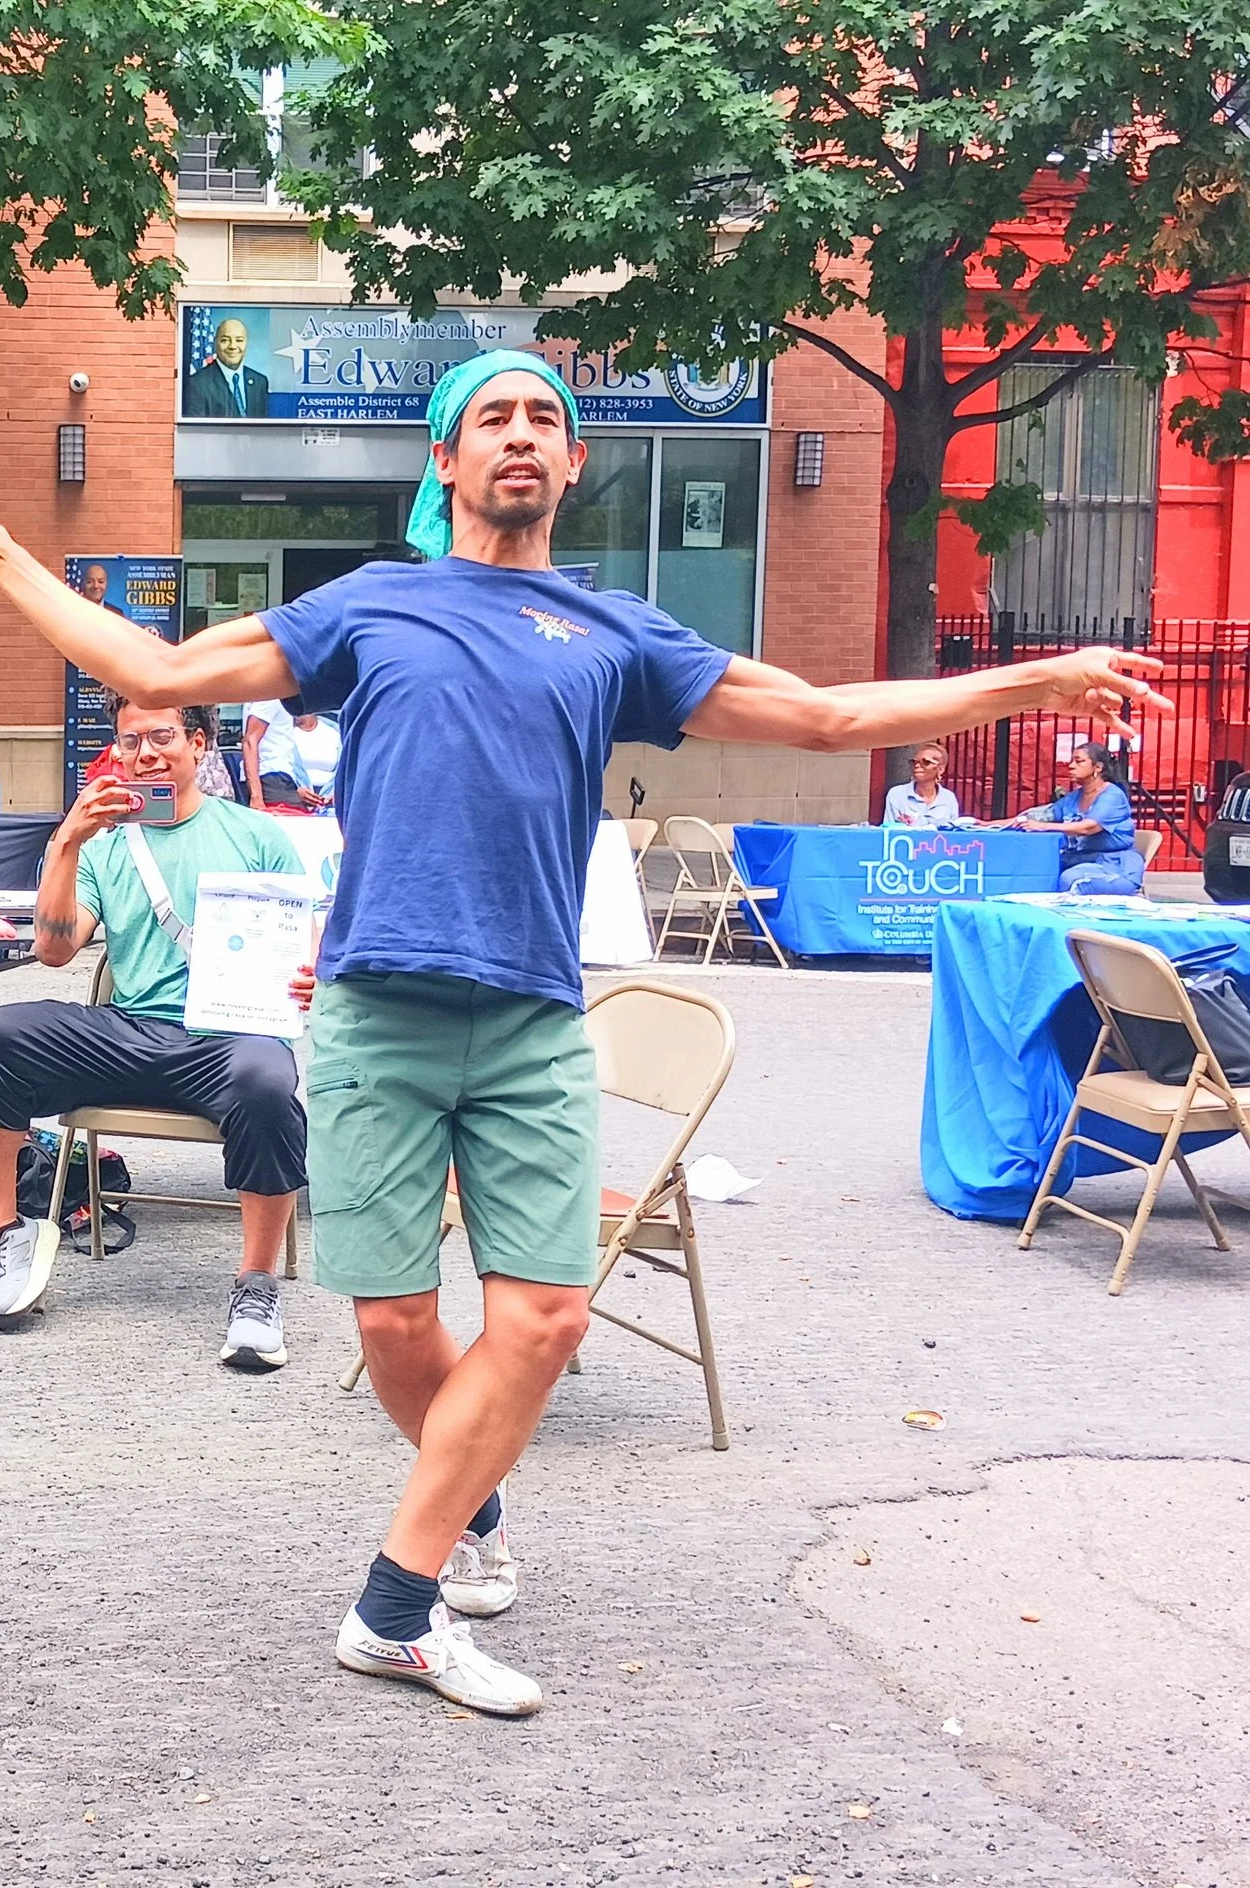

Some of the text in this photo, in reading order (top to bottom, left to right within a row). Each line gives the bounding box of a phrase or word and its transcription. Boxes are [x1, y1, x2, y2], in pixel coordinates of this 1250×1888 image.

[302, 315, 507, 345] Assemblymember
[529, 350, 651, 389] ibbs
[669, 369, 749, 412] STATE OF NEW YORK
[297, 395, 420, 407] Assemble District 68
[600, 399, 654, 409] 828-3953
[297, 409, 398, 419] EAST HARLEM
[579, 411, 628, 421] ARLEM
[126, 580, 176, 590] EDWARD
[126, 591, 176, 606] GIBBS
[278, 898, 303, 908] OPEN
[858, 904, 894, 914] Institute
[894, 904, 907, 914] for
[873, 915, 891, 924] and
